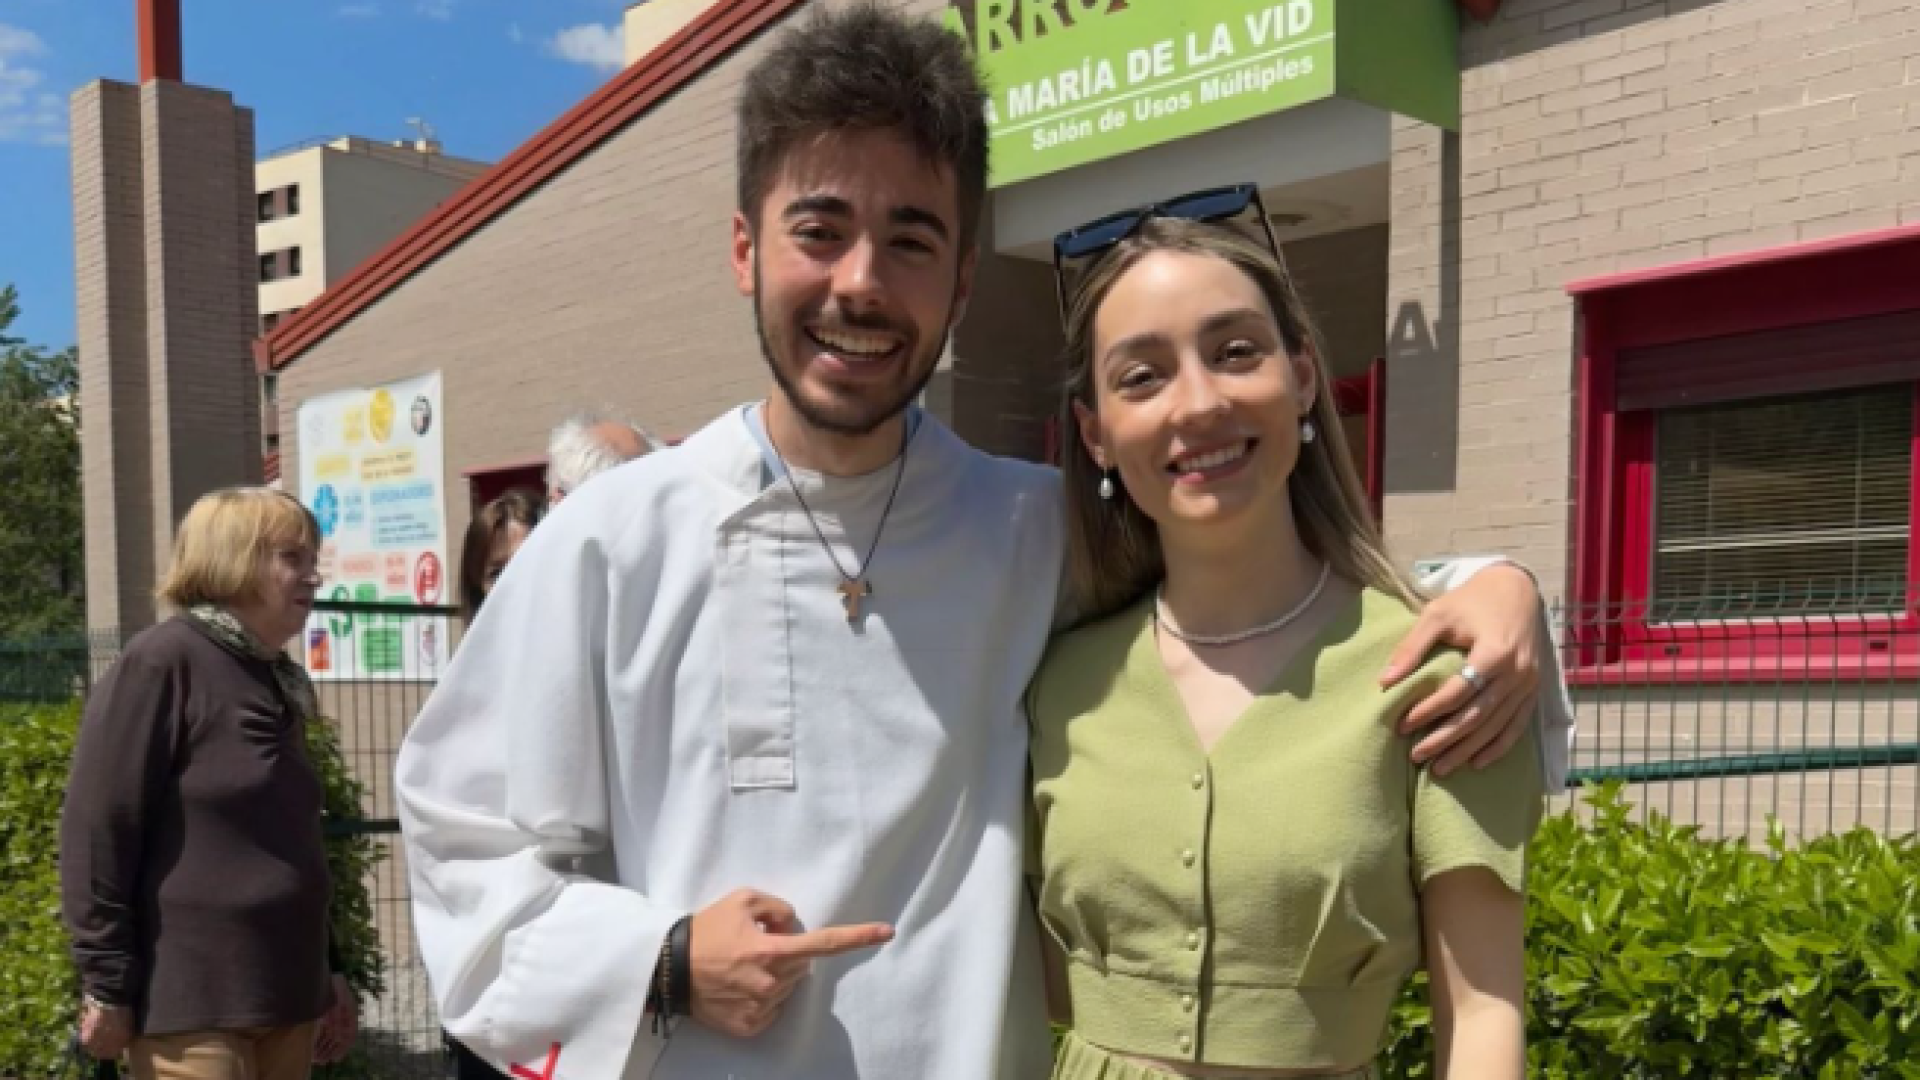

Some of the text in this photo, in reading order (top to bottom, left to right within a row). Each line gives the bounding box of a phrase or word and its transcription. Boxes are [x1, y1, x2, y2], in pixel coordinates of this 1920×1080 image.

[1007, 56, 1117, 119] MARÍA
[1127, 38, 1176, 85] DE
[1186, 22, 1234, 68] LA
[1245, 0, 1314, 47] VID
[1032, 55, 1314, 151] Salón de Usos Múltiples
